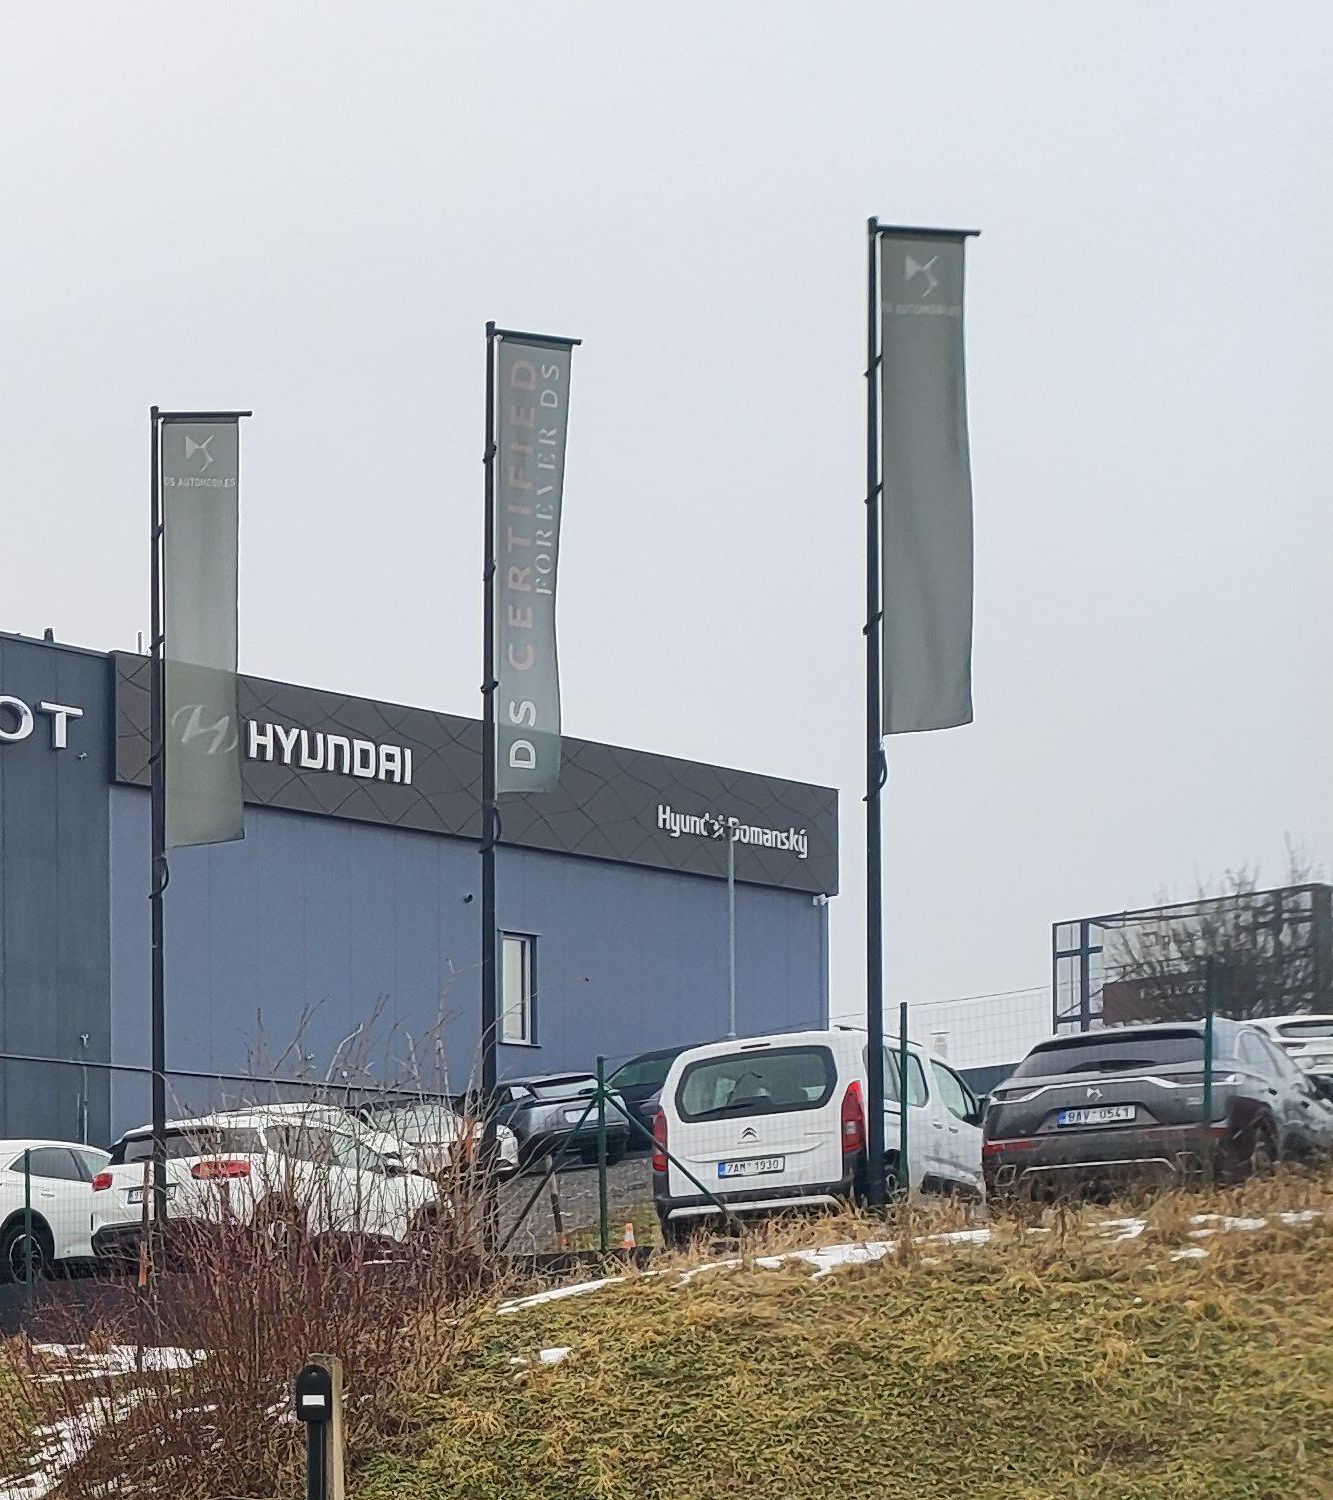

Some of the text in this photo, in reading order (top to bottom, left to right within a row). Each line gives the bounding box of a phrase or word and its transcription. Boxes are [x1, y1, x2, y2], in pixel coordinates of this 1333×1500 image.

[540, 363, 560, 408] DS
[507, 358, 537, 770] DS CERTIFIED
[247, 719, 413, 786] HYUNDAI
